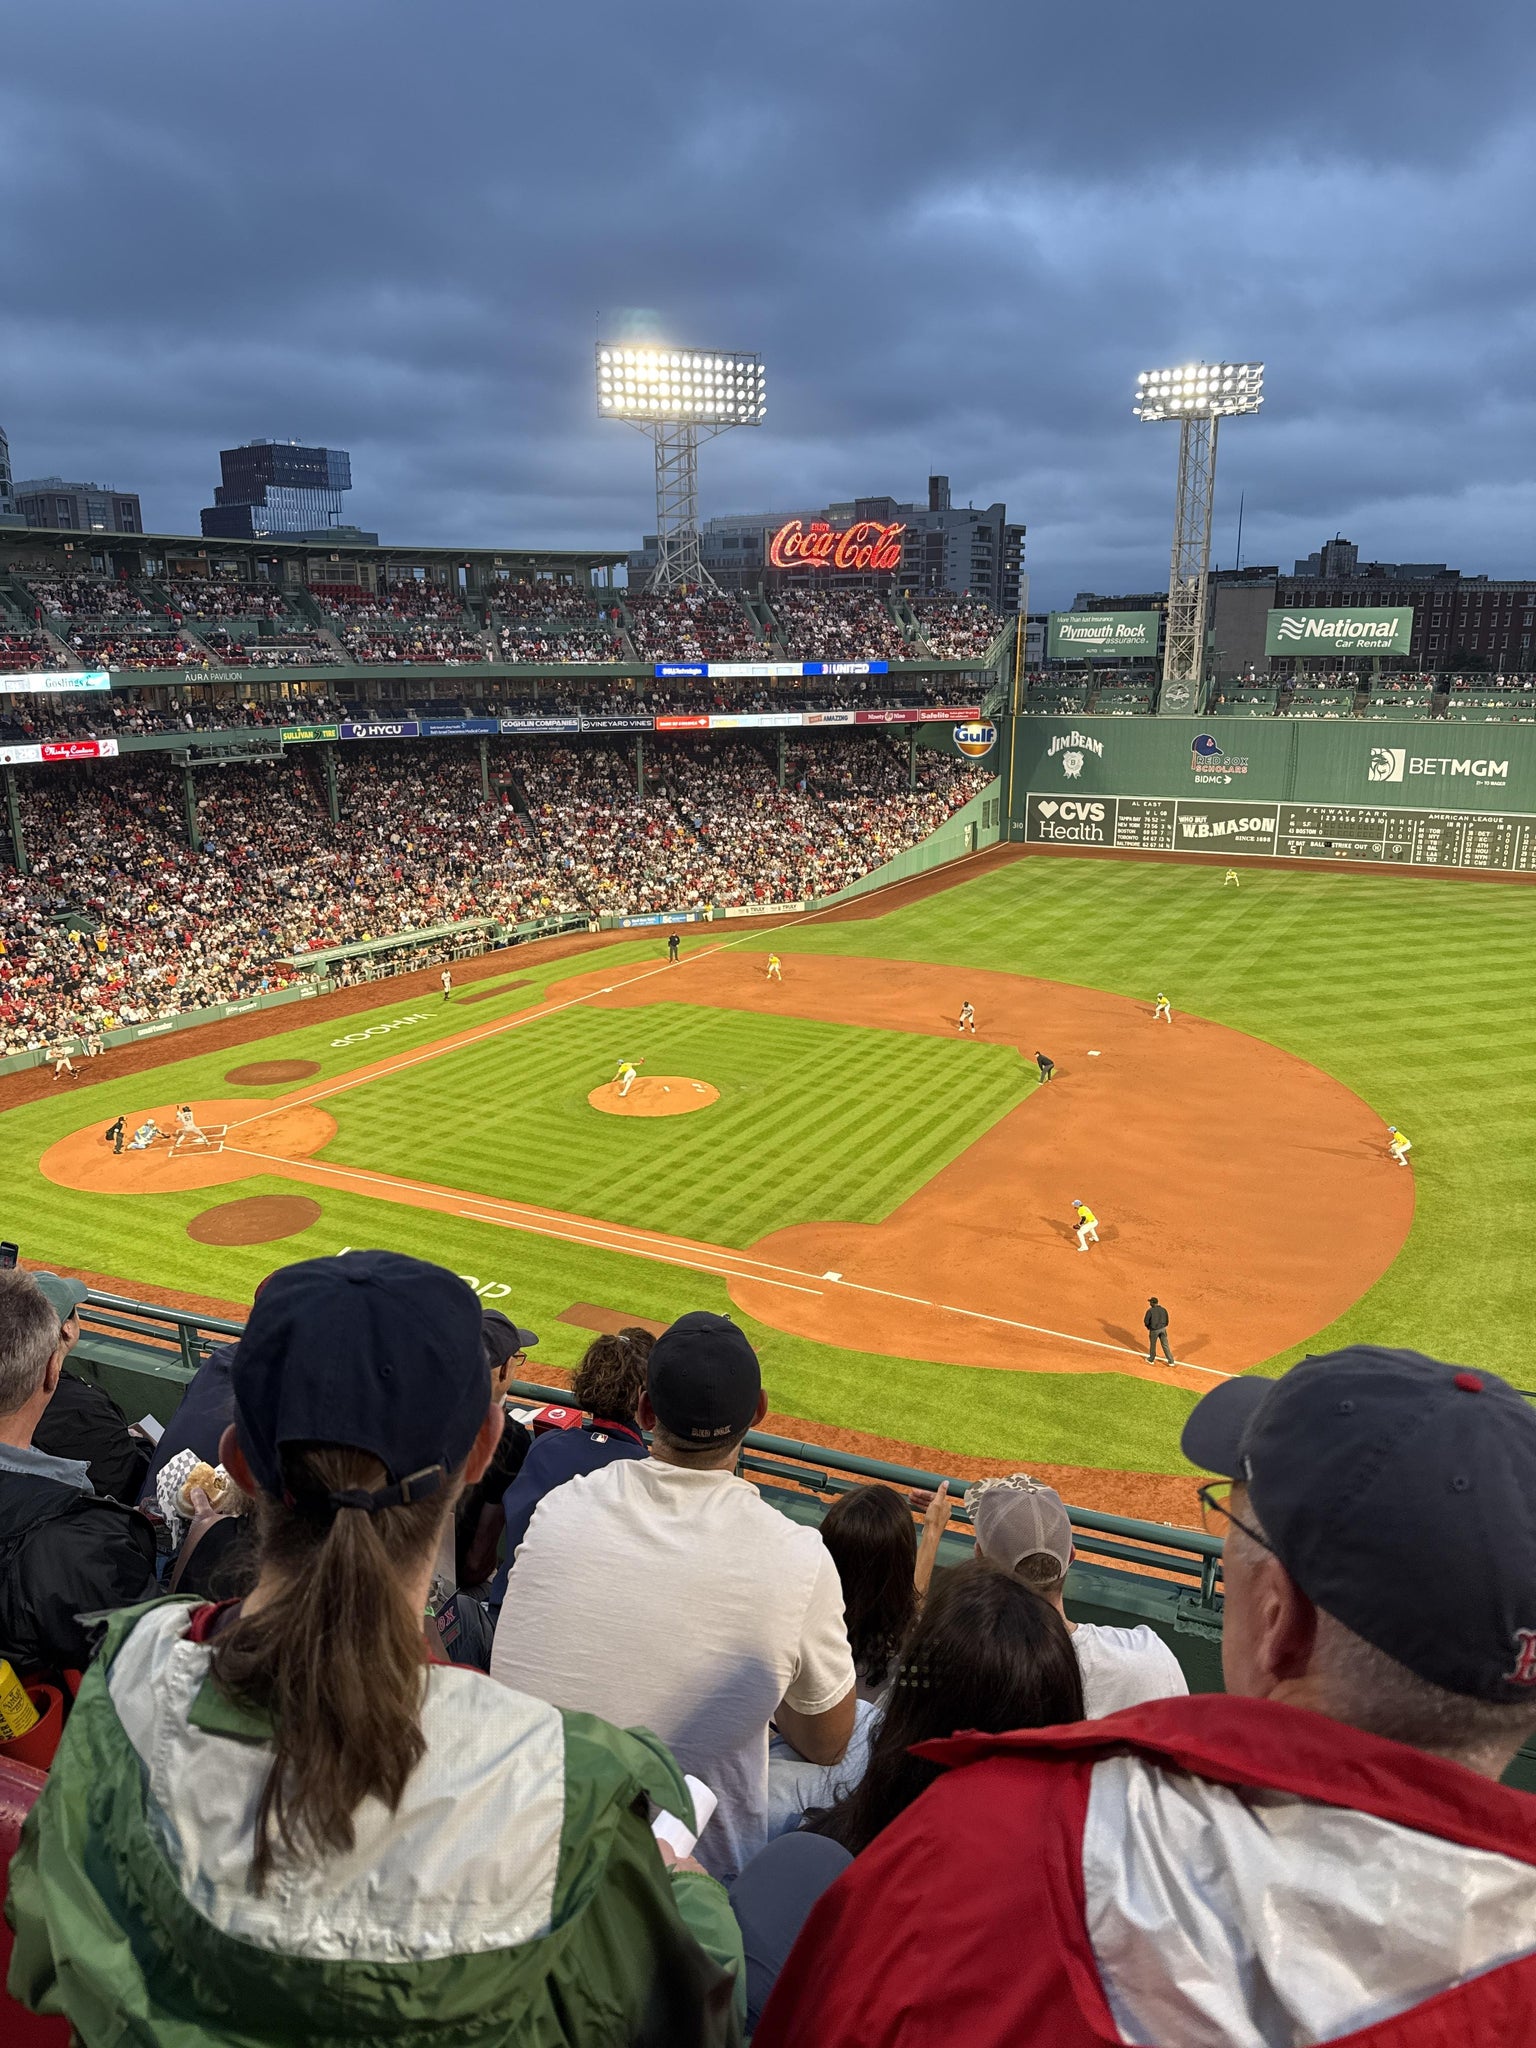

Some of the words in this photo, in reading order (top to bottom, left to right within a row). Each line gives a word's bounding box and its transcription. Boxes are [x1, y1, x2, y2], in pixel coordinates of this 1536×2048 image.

[770, 520, 906, 569] Coca-Cola
[1059, 624, 1113, 639] Plymouth
[1115, 623, 1146, 637] Rock
[1335, 640, 1354, 648] Car
[1356, 639, 1392, 648] Rental
[210, 672, 242, 680] PAVILION
[45, 678, 84, 688] Goslings
[920, 711, 950, 719] Safelite
[502, 720, 535, 728] COGHLIN
[283, 730, 314, 740] SULLIVAN
[322, 729, 336, 738] TIRE
[369, 725, 401, 735] HYCU
[955, 727, 995, 742] Gulf
[1197, 756, 1220, 765] RED
[1223, 756, 1249, 766] SOX
[1195, 764, 1248, 774] SCHOLARS
[1409, 757, 1509, 778] BETMGM
[1194, 775, 1222, 784] BIDMC
[1059, 801, 1105, 822] CVS
[1306, 808, 1350, 816] FENWAY
[1012, 822, 1024, 830] 310
[1039, 820, 1104, 841] Health
[1289, 845, 1302, 855] 51
[330, 1013, 438, 1048] WHOOP
